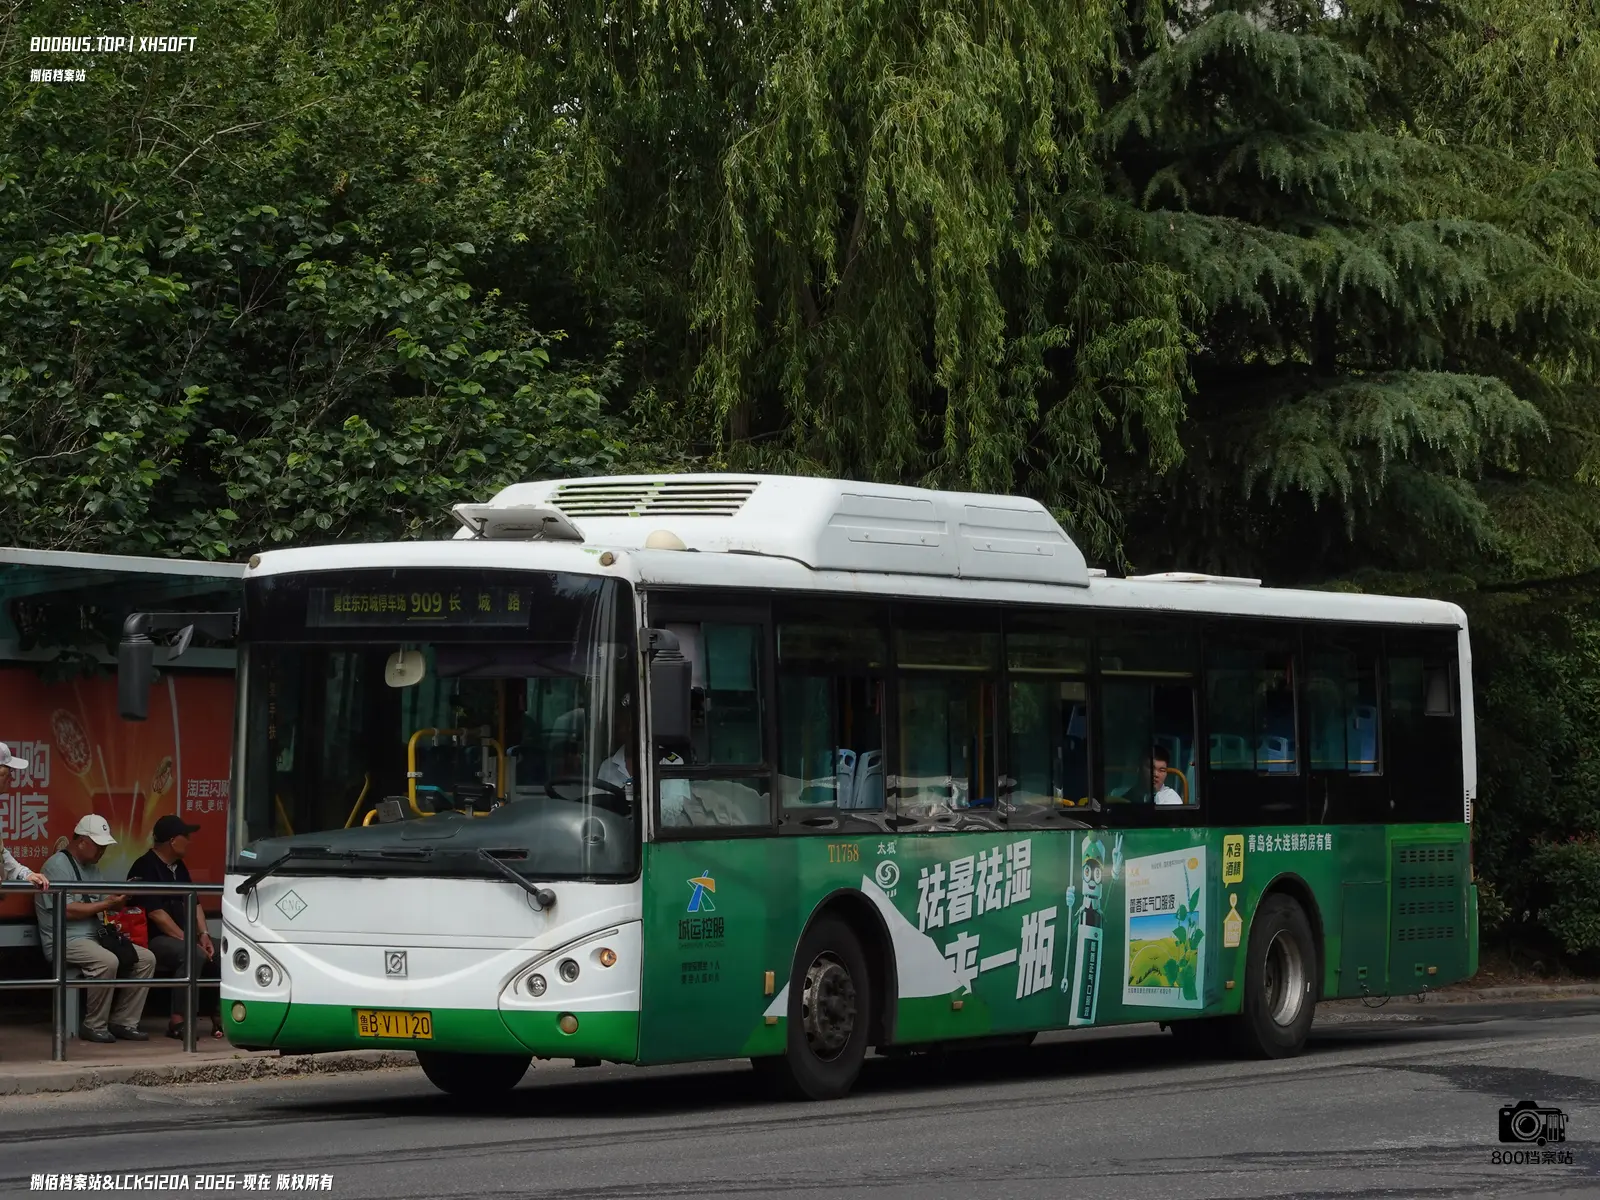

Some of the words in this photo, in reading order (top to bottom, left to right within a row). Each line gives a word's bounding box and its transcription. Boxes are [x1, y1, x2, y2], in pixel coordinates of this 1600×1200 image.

[411, 592, 442, 613] 909
[828, 843, 859, 863] T1758
[1226, 843, 1241, 858] 不含
[1248, 832, 1332, 853] 青岛各大连锁药房有售
[917, 838, 1032, 934] 祛暑祛湿
[281, 899, 301, 911] CNG
[678, 917, 725, 940] 城运控股
